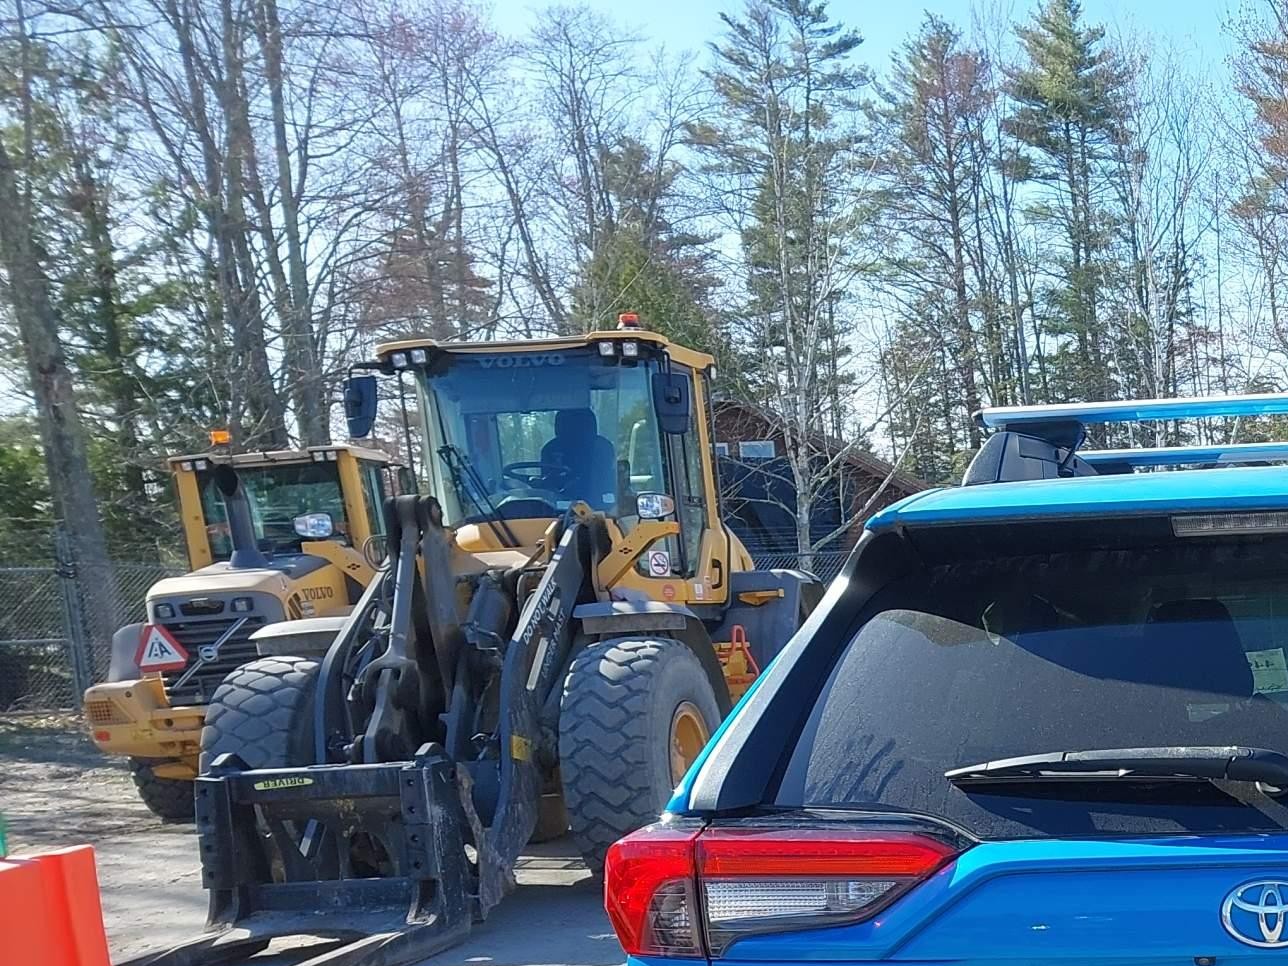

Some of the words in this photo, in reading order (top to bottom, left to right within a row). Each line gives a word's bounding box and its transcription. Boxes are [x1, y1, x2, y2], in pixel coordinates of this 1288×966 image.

[473, 353, 565, 368] VOLVO
[302, 586, 334, 600] VOLVO
[523, 626, 533, 644] DO
[540, 576, 557, 604] WALK
[263, 777, 305, 788] DRIVER
